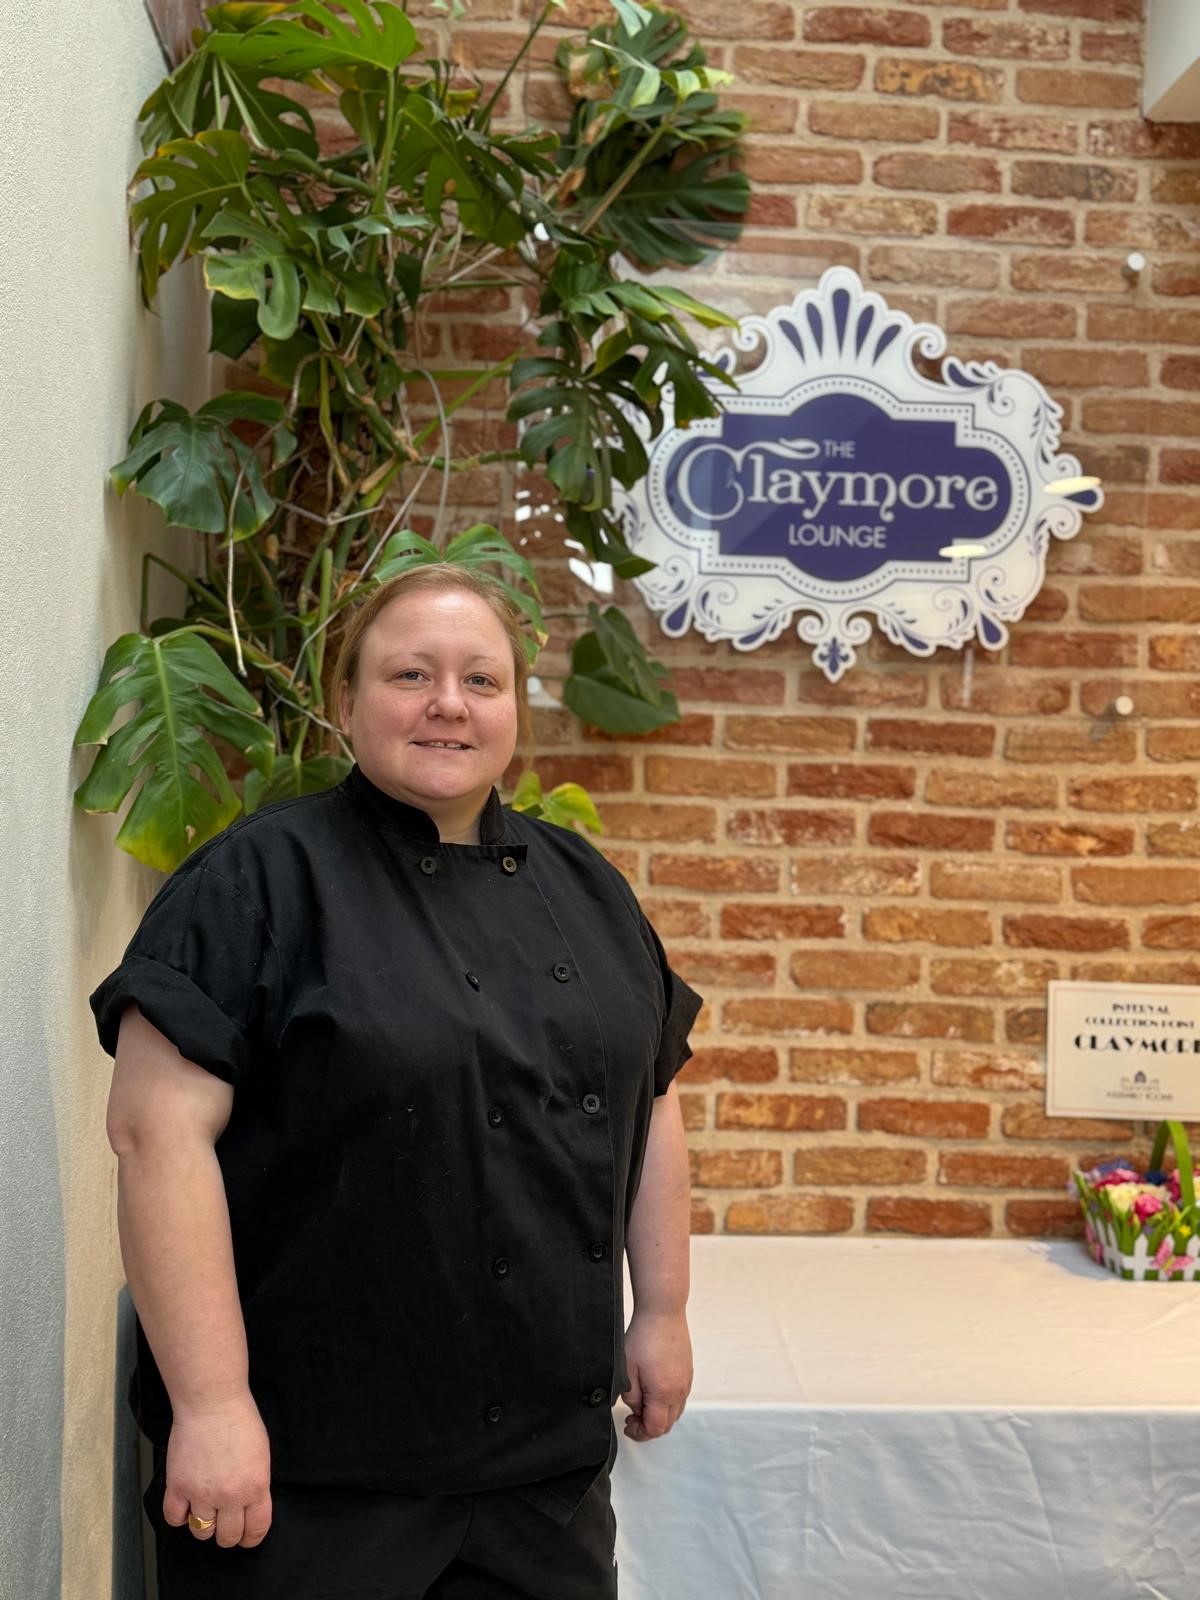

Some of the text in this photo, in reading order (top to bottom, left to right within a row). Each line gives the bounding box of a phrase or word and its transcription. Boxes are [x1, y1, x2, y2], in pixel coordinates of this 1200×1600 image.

[823, 440, 856, 459] THE
[677, 438, 999, 522] Claymore
[788, 524, 887, 548] LOUNGE
